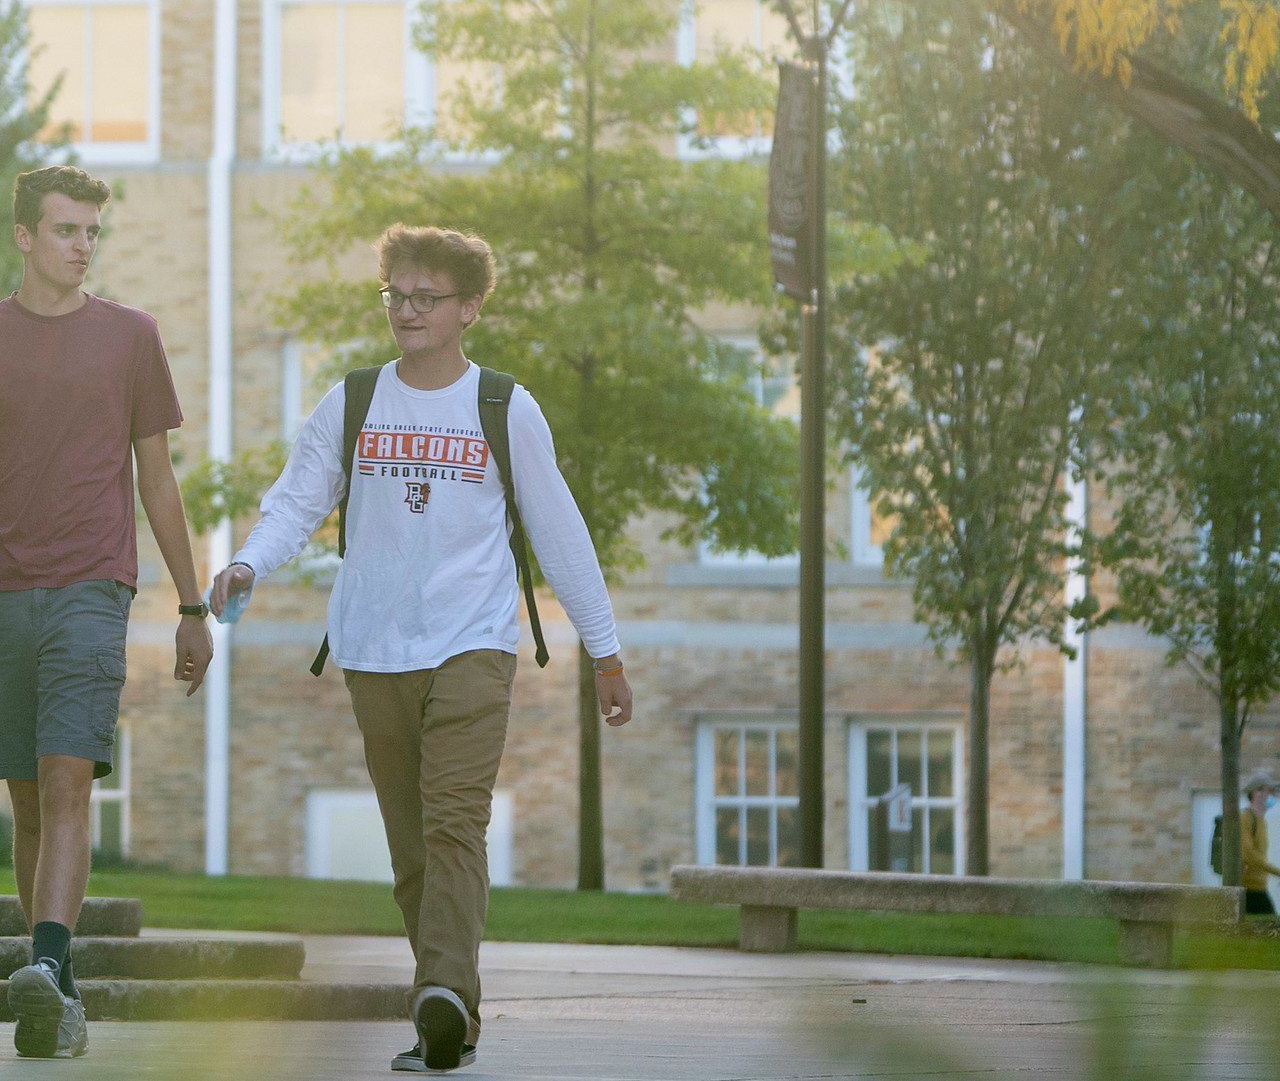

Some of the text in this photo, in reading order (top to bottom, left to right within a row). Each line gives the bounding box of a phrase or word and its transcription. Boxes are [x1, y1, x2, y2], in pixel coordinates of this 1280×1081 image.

[364, 423, 391, 431] OWLING
[419, 425, 442, 433] STATE
[363, 433, 485, 464] FALCONS
[381, 466, 457, 481] FOOTBALL
